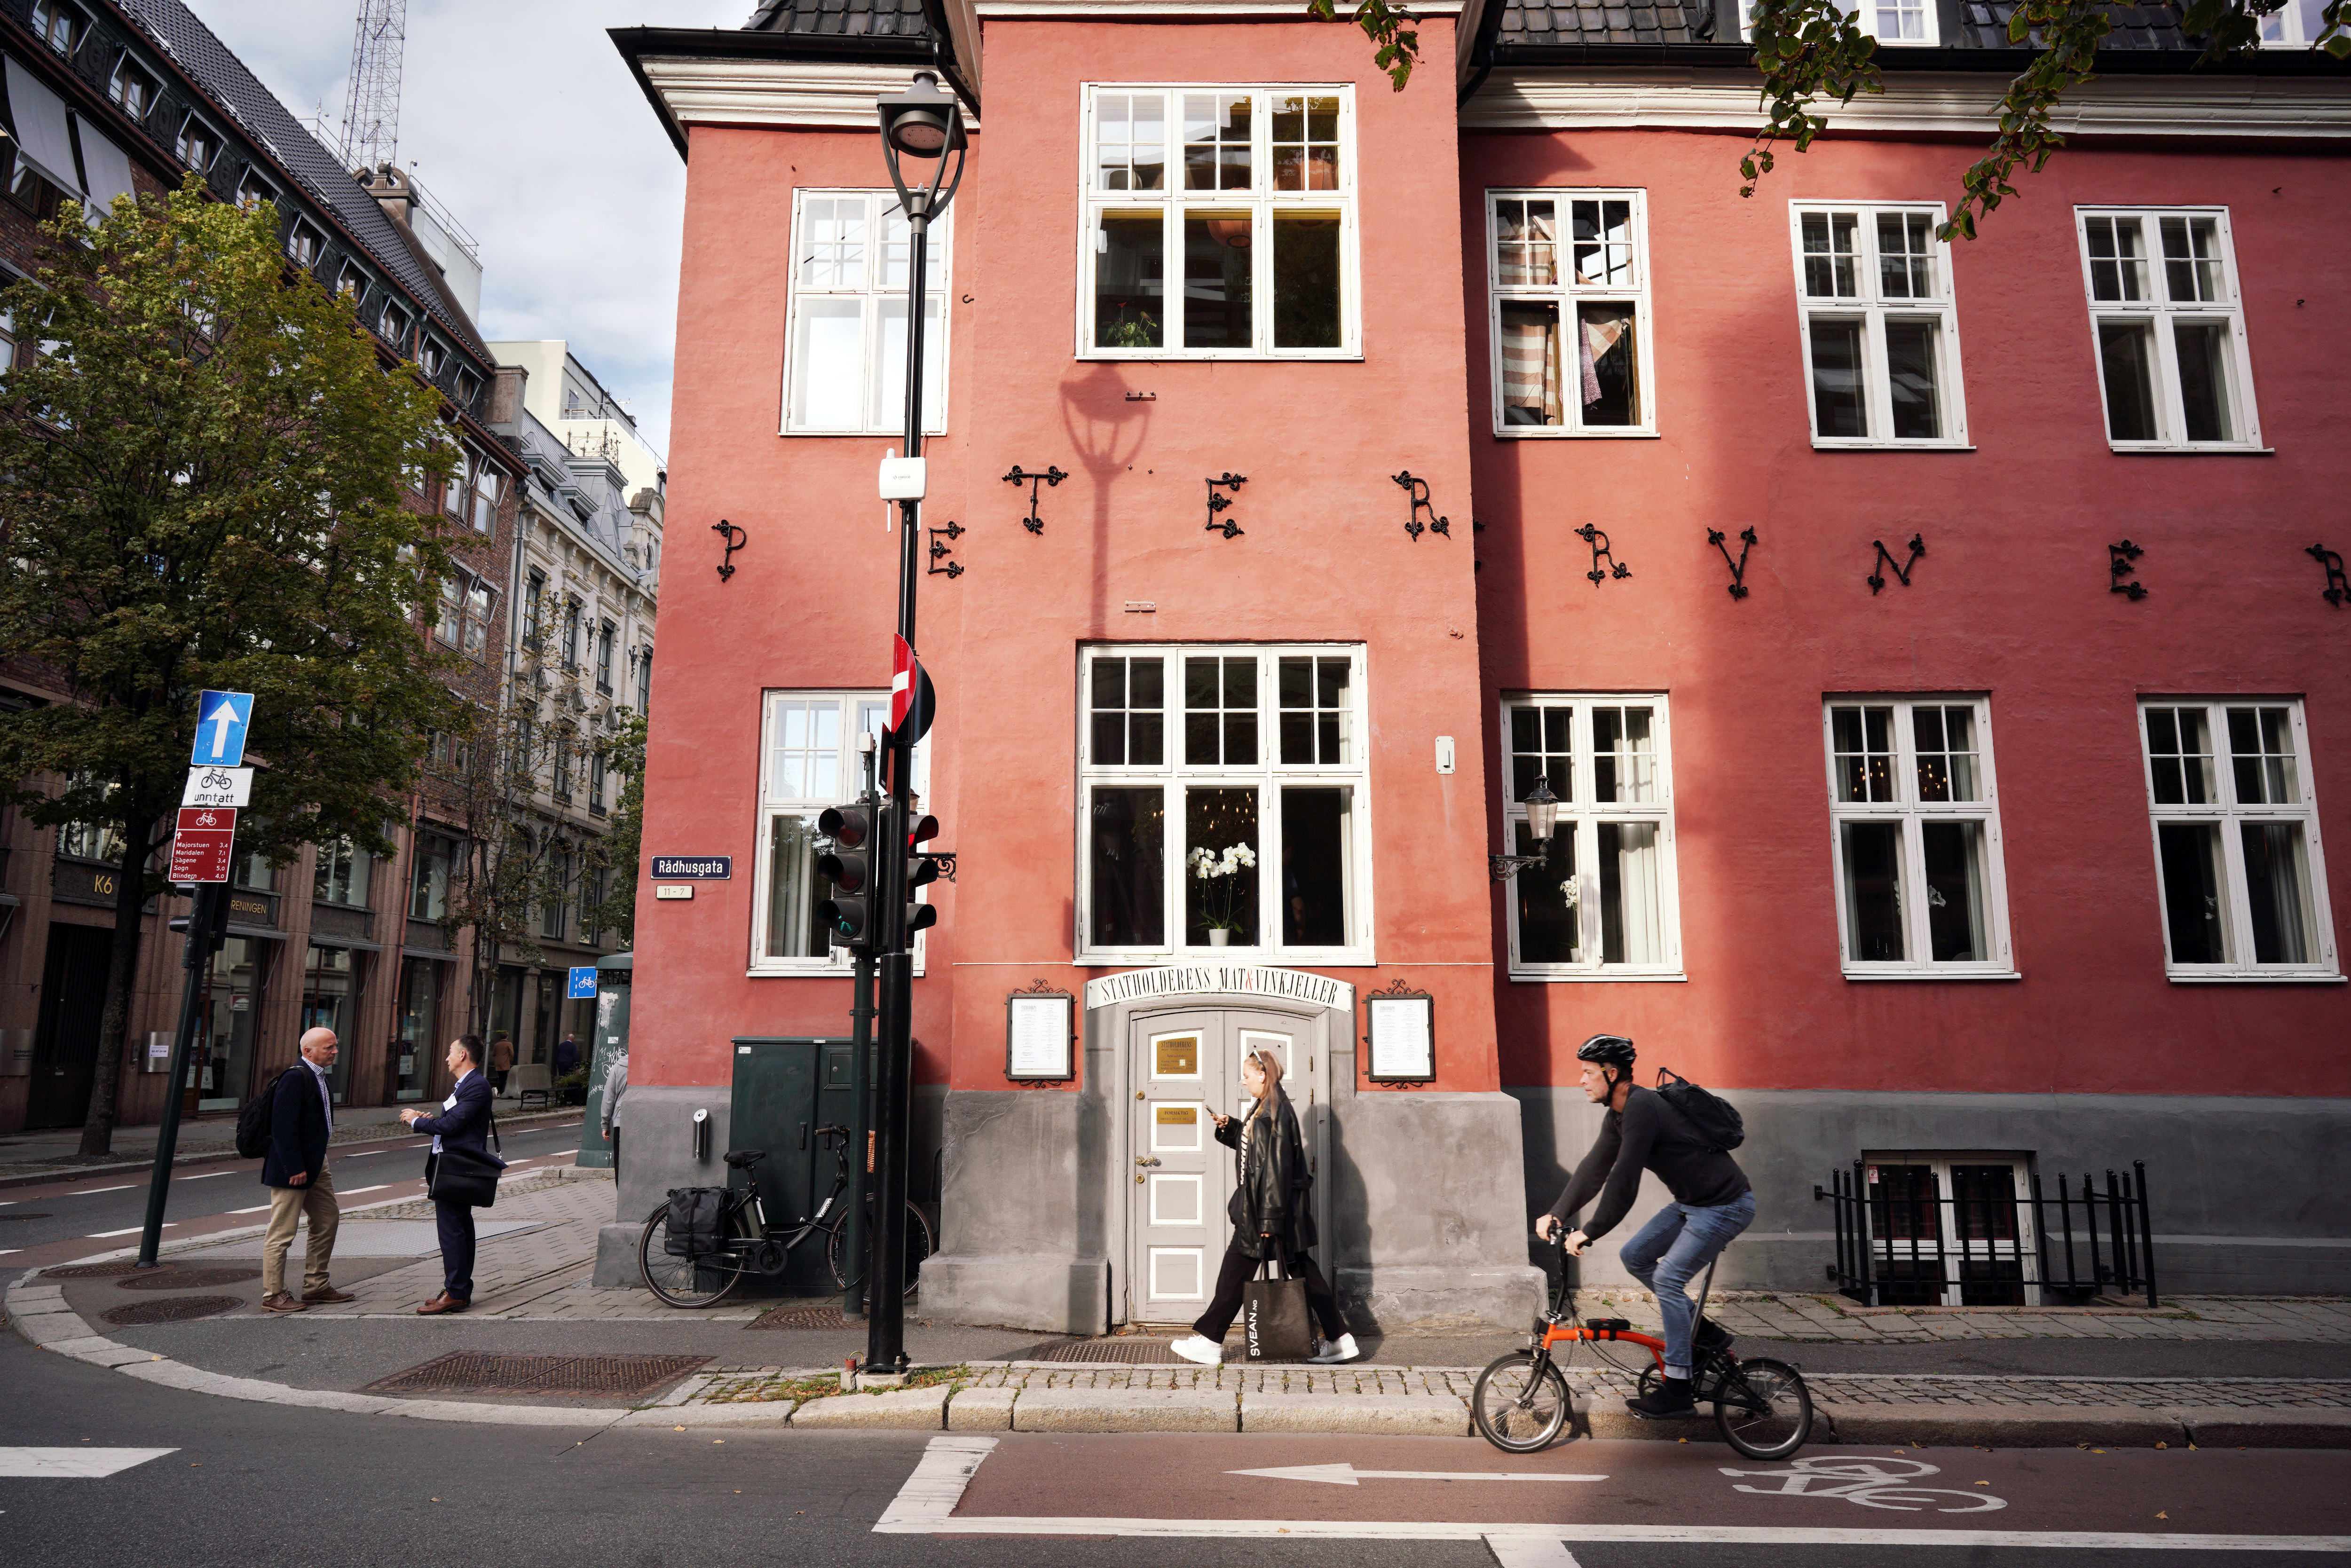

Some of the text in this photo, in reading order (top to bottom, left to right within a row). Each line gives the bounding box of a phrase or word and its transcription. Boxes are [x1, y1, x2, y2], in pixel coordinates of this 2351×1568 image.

[194, 793, 234, 803] unntatt
[659, 859, 723, 876] Rådhusgata
[94, 875, 113, 894] K6
[663, 888, 671, 896] 11
[230, 899, 267, 914] RENINGEN
[1100, 967, 1211, 1002] STATHOLDERENS
